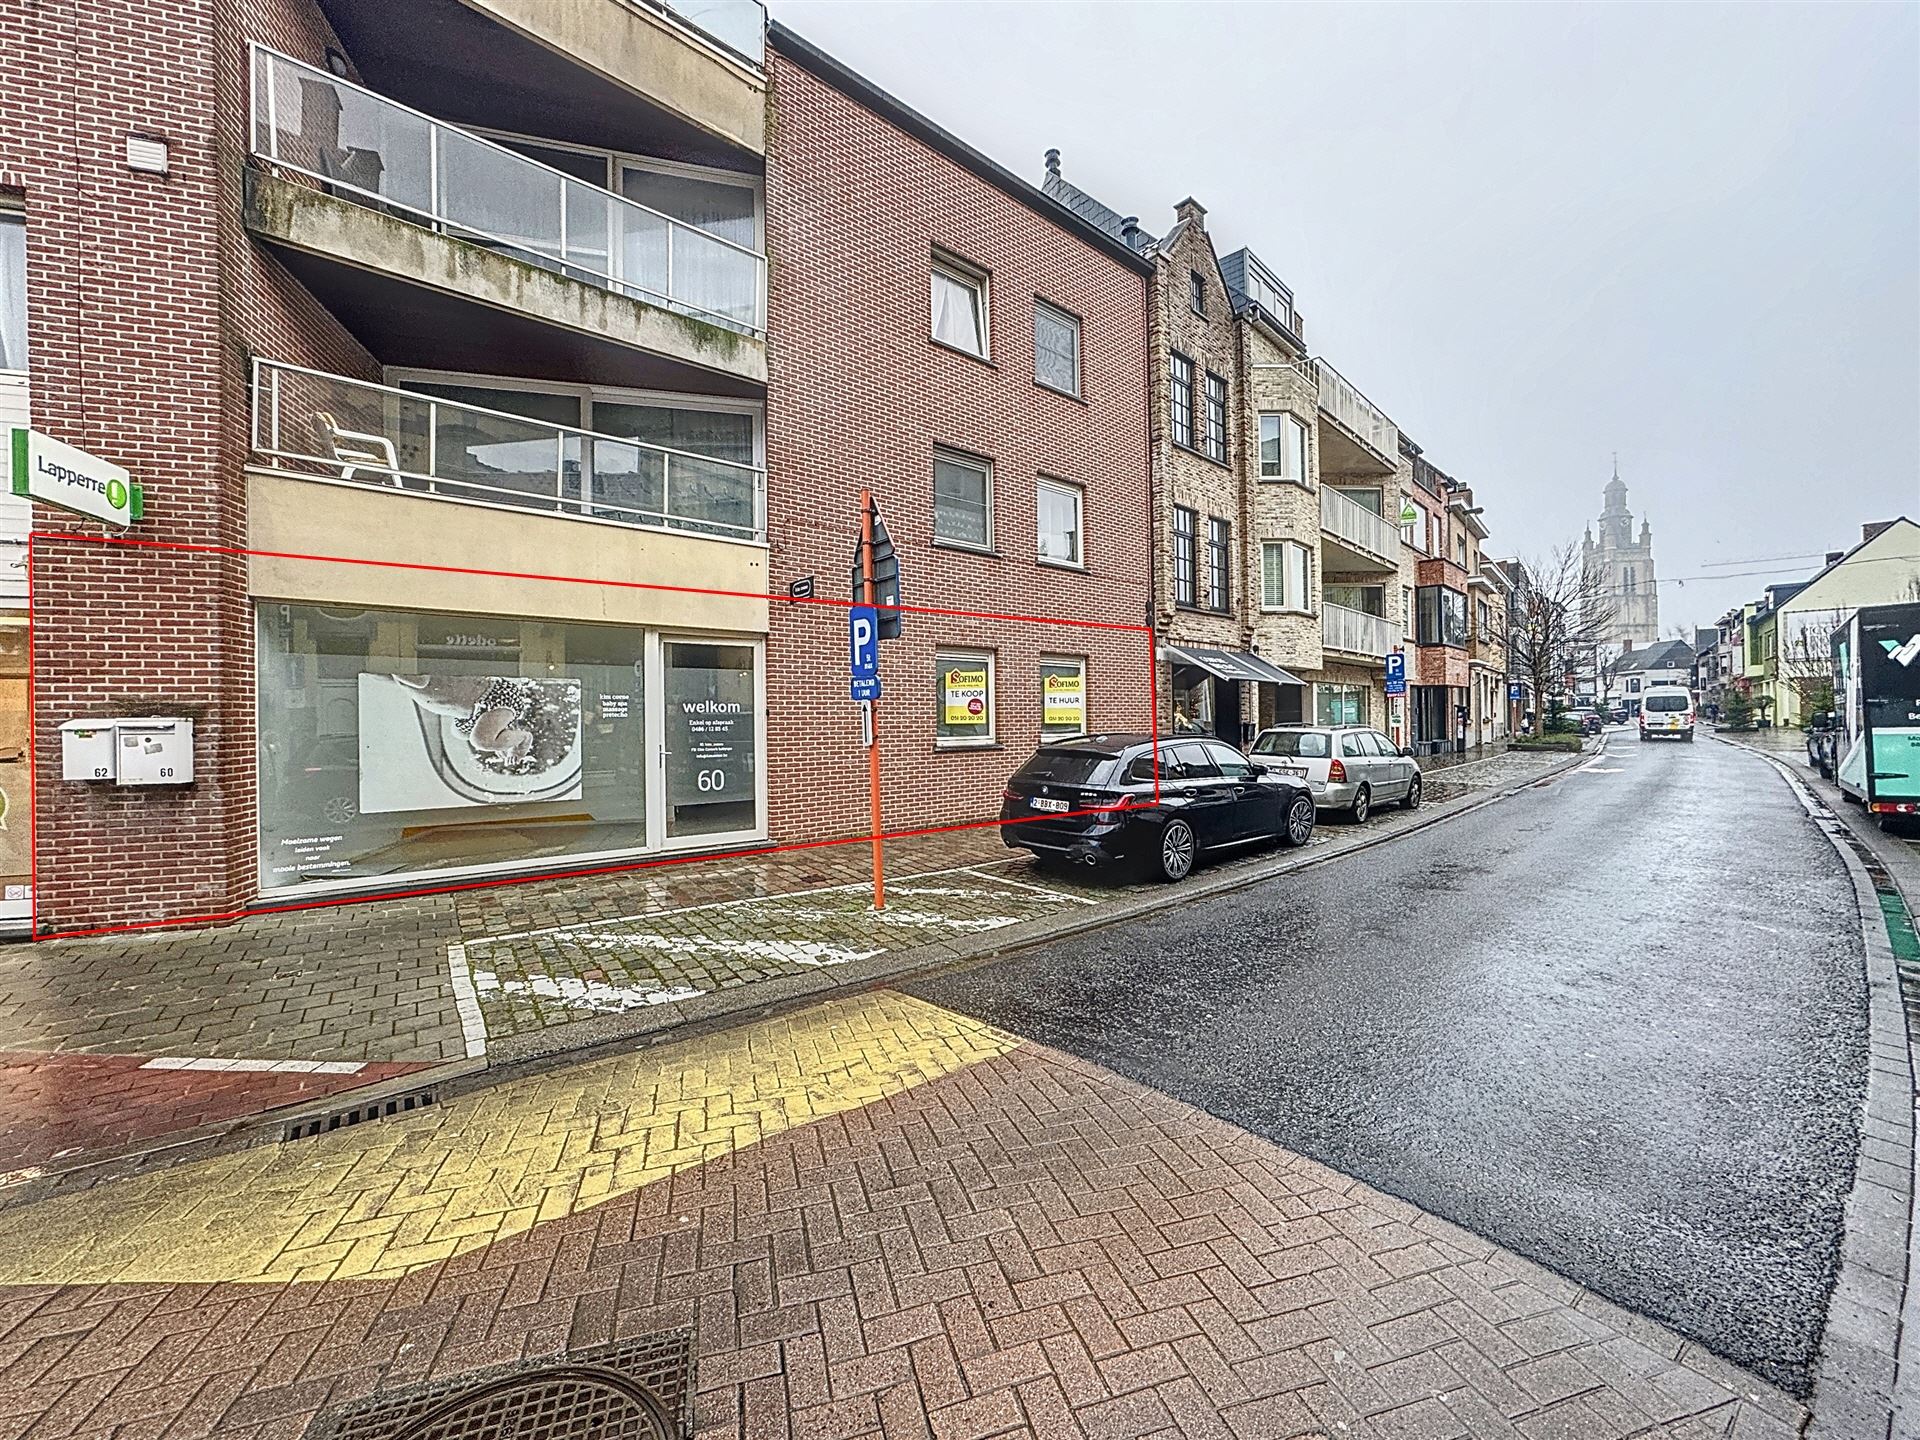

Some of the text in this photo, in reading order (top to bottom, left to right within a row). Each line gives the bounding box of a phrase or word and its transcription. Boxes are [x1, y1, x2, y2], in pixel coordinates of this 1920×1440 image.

[37, 455, 106, 495] Lapperre
[854, 619, 871, 666] P
[1388, 656, 1402, 674] P
[962, 690, 984, 698] KOOP
[682, 700, 741, 713] welkom
[94, 768, 108, 777] 62
[160, 768, 174, 777] 60
[697, 769, 725, 791] 60
